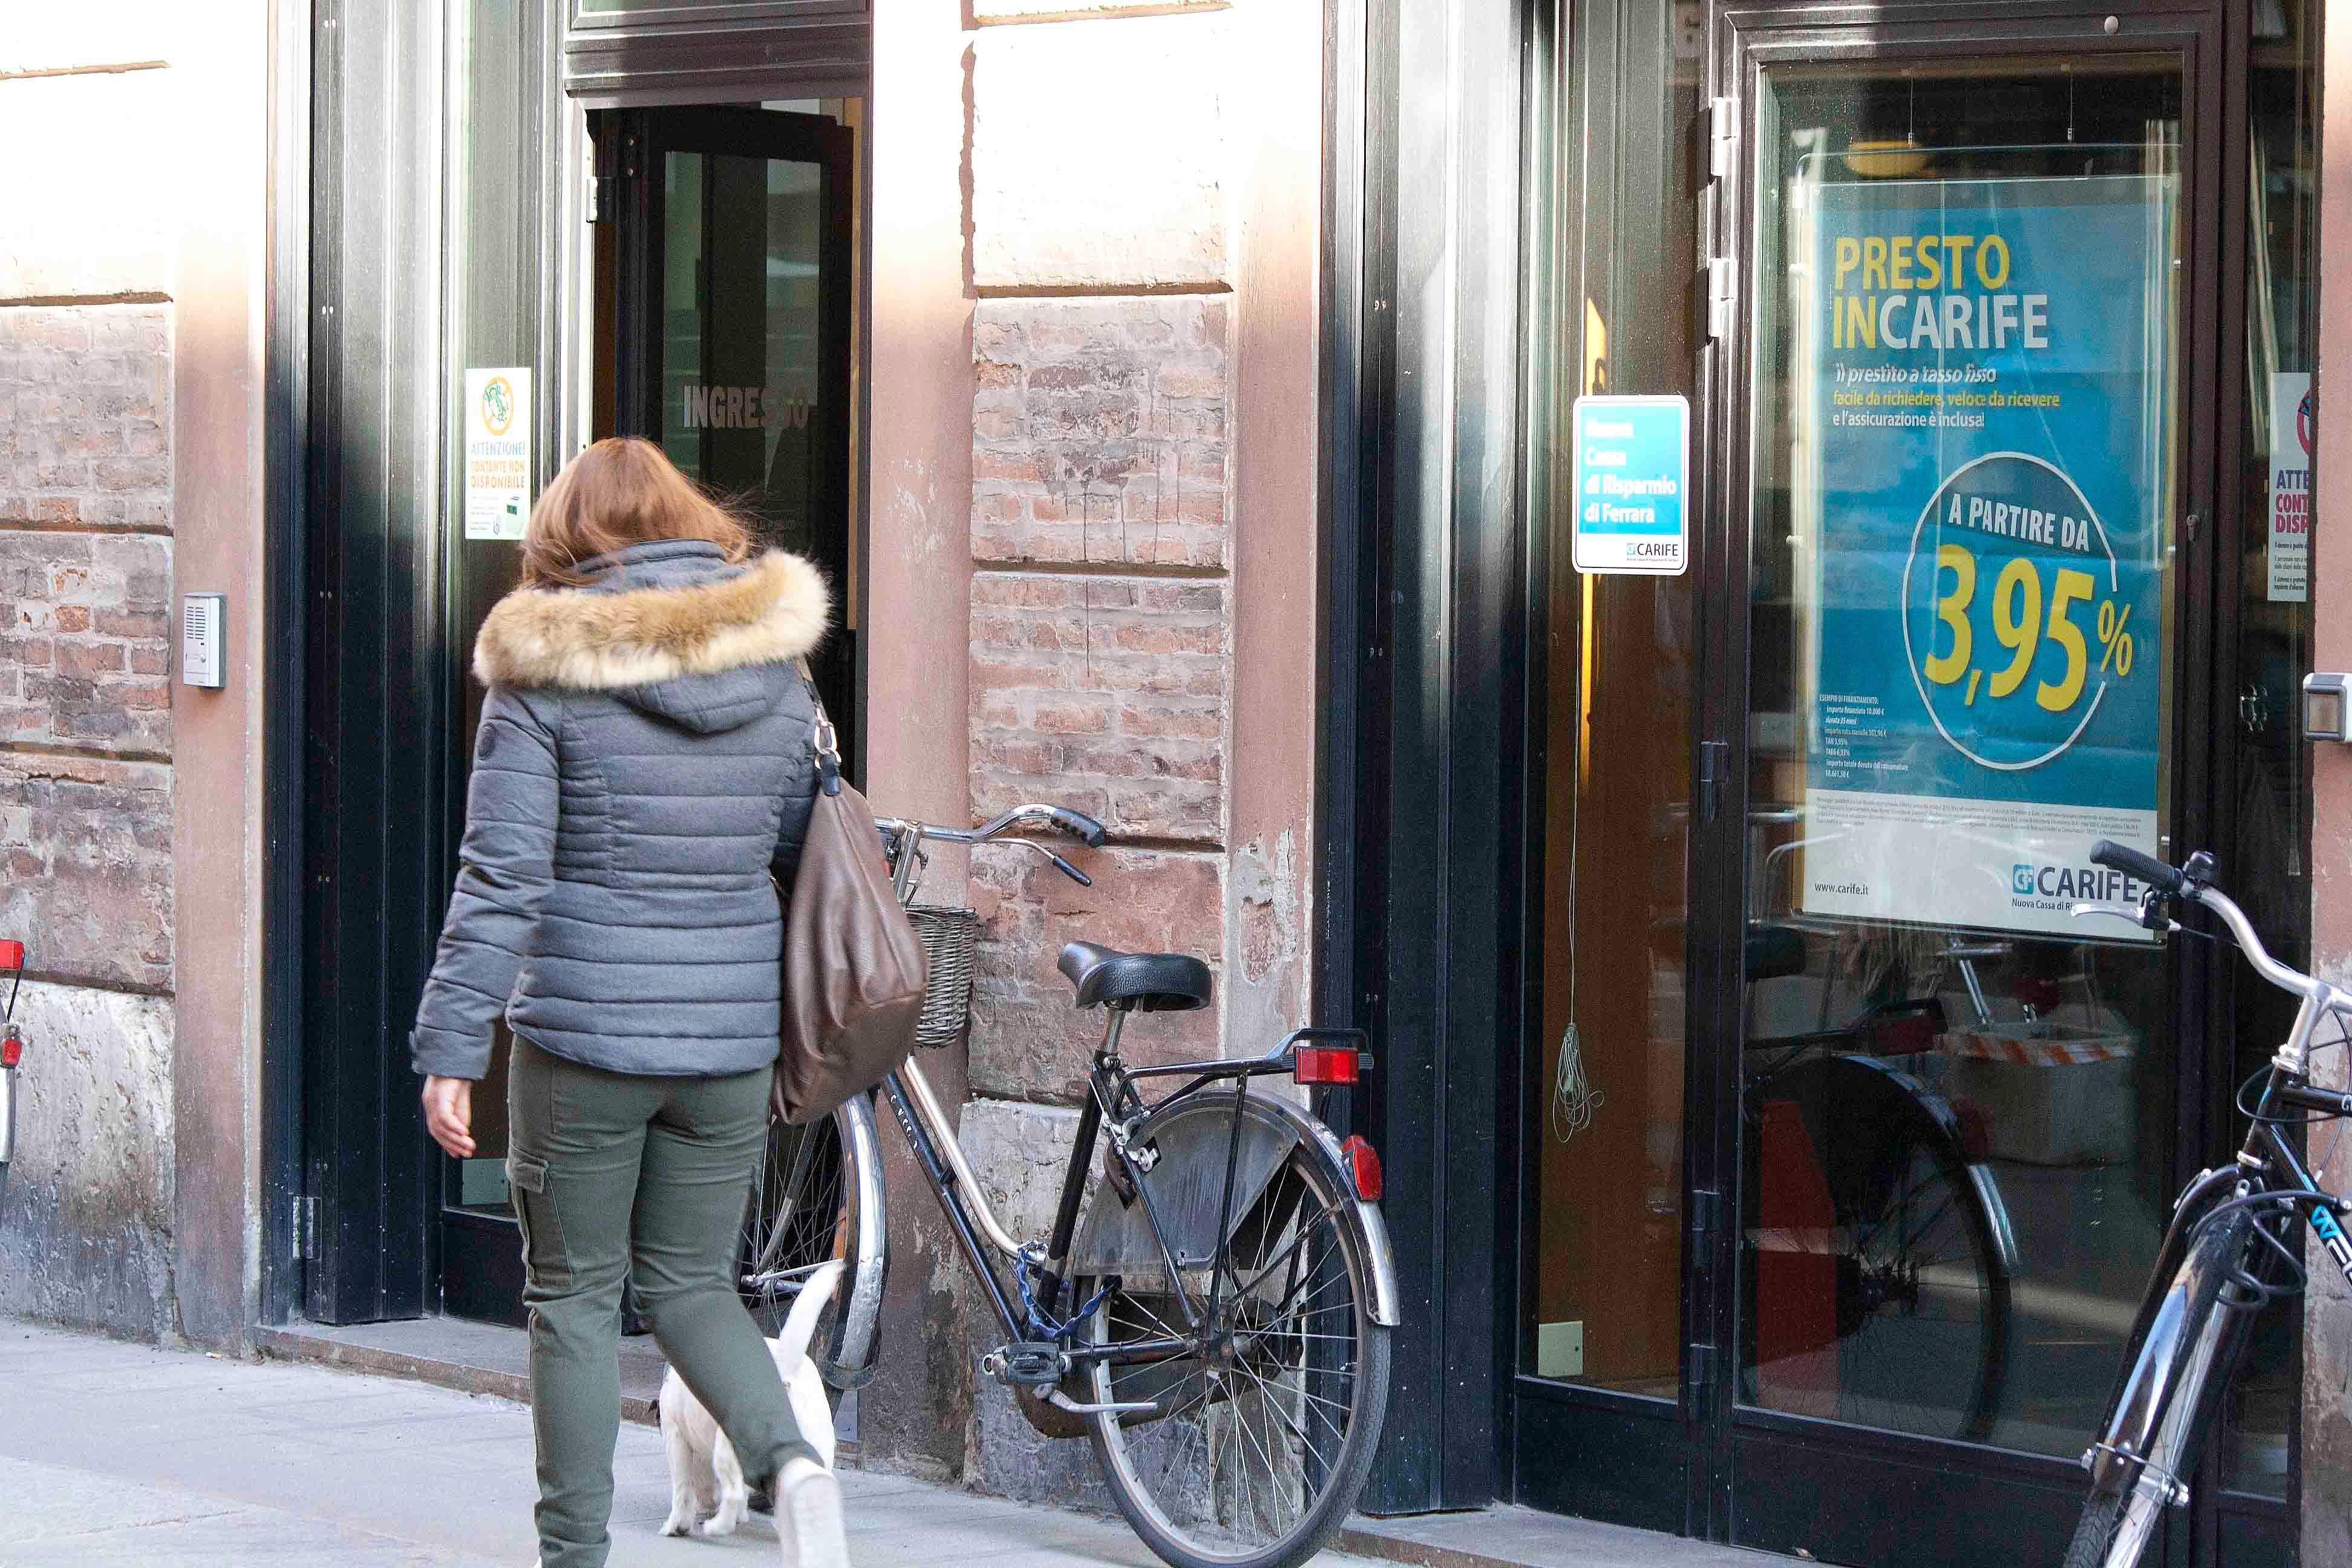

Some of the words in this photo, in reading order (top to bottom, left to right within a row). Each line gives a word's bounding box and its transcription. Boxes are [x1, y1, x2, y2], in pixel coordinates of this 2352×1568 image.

[1834, 235, 2011, 290] PRESTO
[1833, 294, 2048, 349] INCARIFE
[1847, 364, 1907, 387] prestito
[1909, 370, 1919, 382] a
[1922, 365, 1962, 383] tasso
[1834, 391, 1863, 407] facile
[1866, 392, 1880, 407] da
[1988, 391, 2005, 408] da
[2007, 391, 2061, 407] ricevere
[1842, 411, 1927, 427] l'assicurazione
[1938, 412, 1985, 429] inclusa!
[471, 440, 525, 456] ATTENZIONE!
[471, 474, 525, 489] DISPONIBILE
[1949, 493, 1962, 524] A
[1968, 496, 2056, 544] PARTIRE
[2061, 515, 2089, 552] DA
[1637, 543, 1678, 556] CARIFE
[1815, 883, 1869, 895] www.carife.it
[2037, 867, 2138, 902] CARIFE
[2012, 898, 2034, 908] Nuova
[2036, 900, 2055, 910] Cassa
[2057, 901, 2064, 910] di
